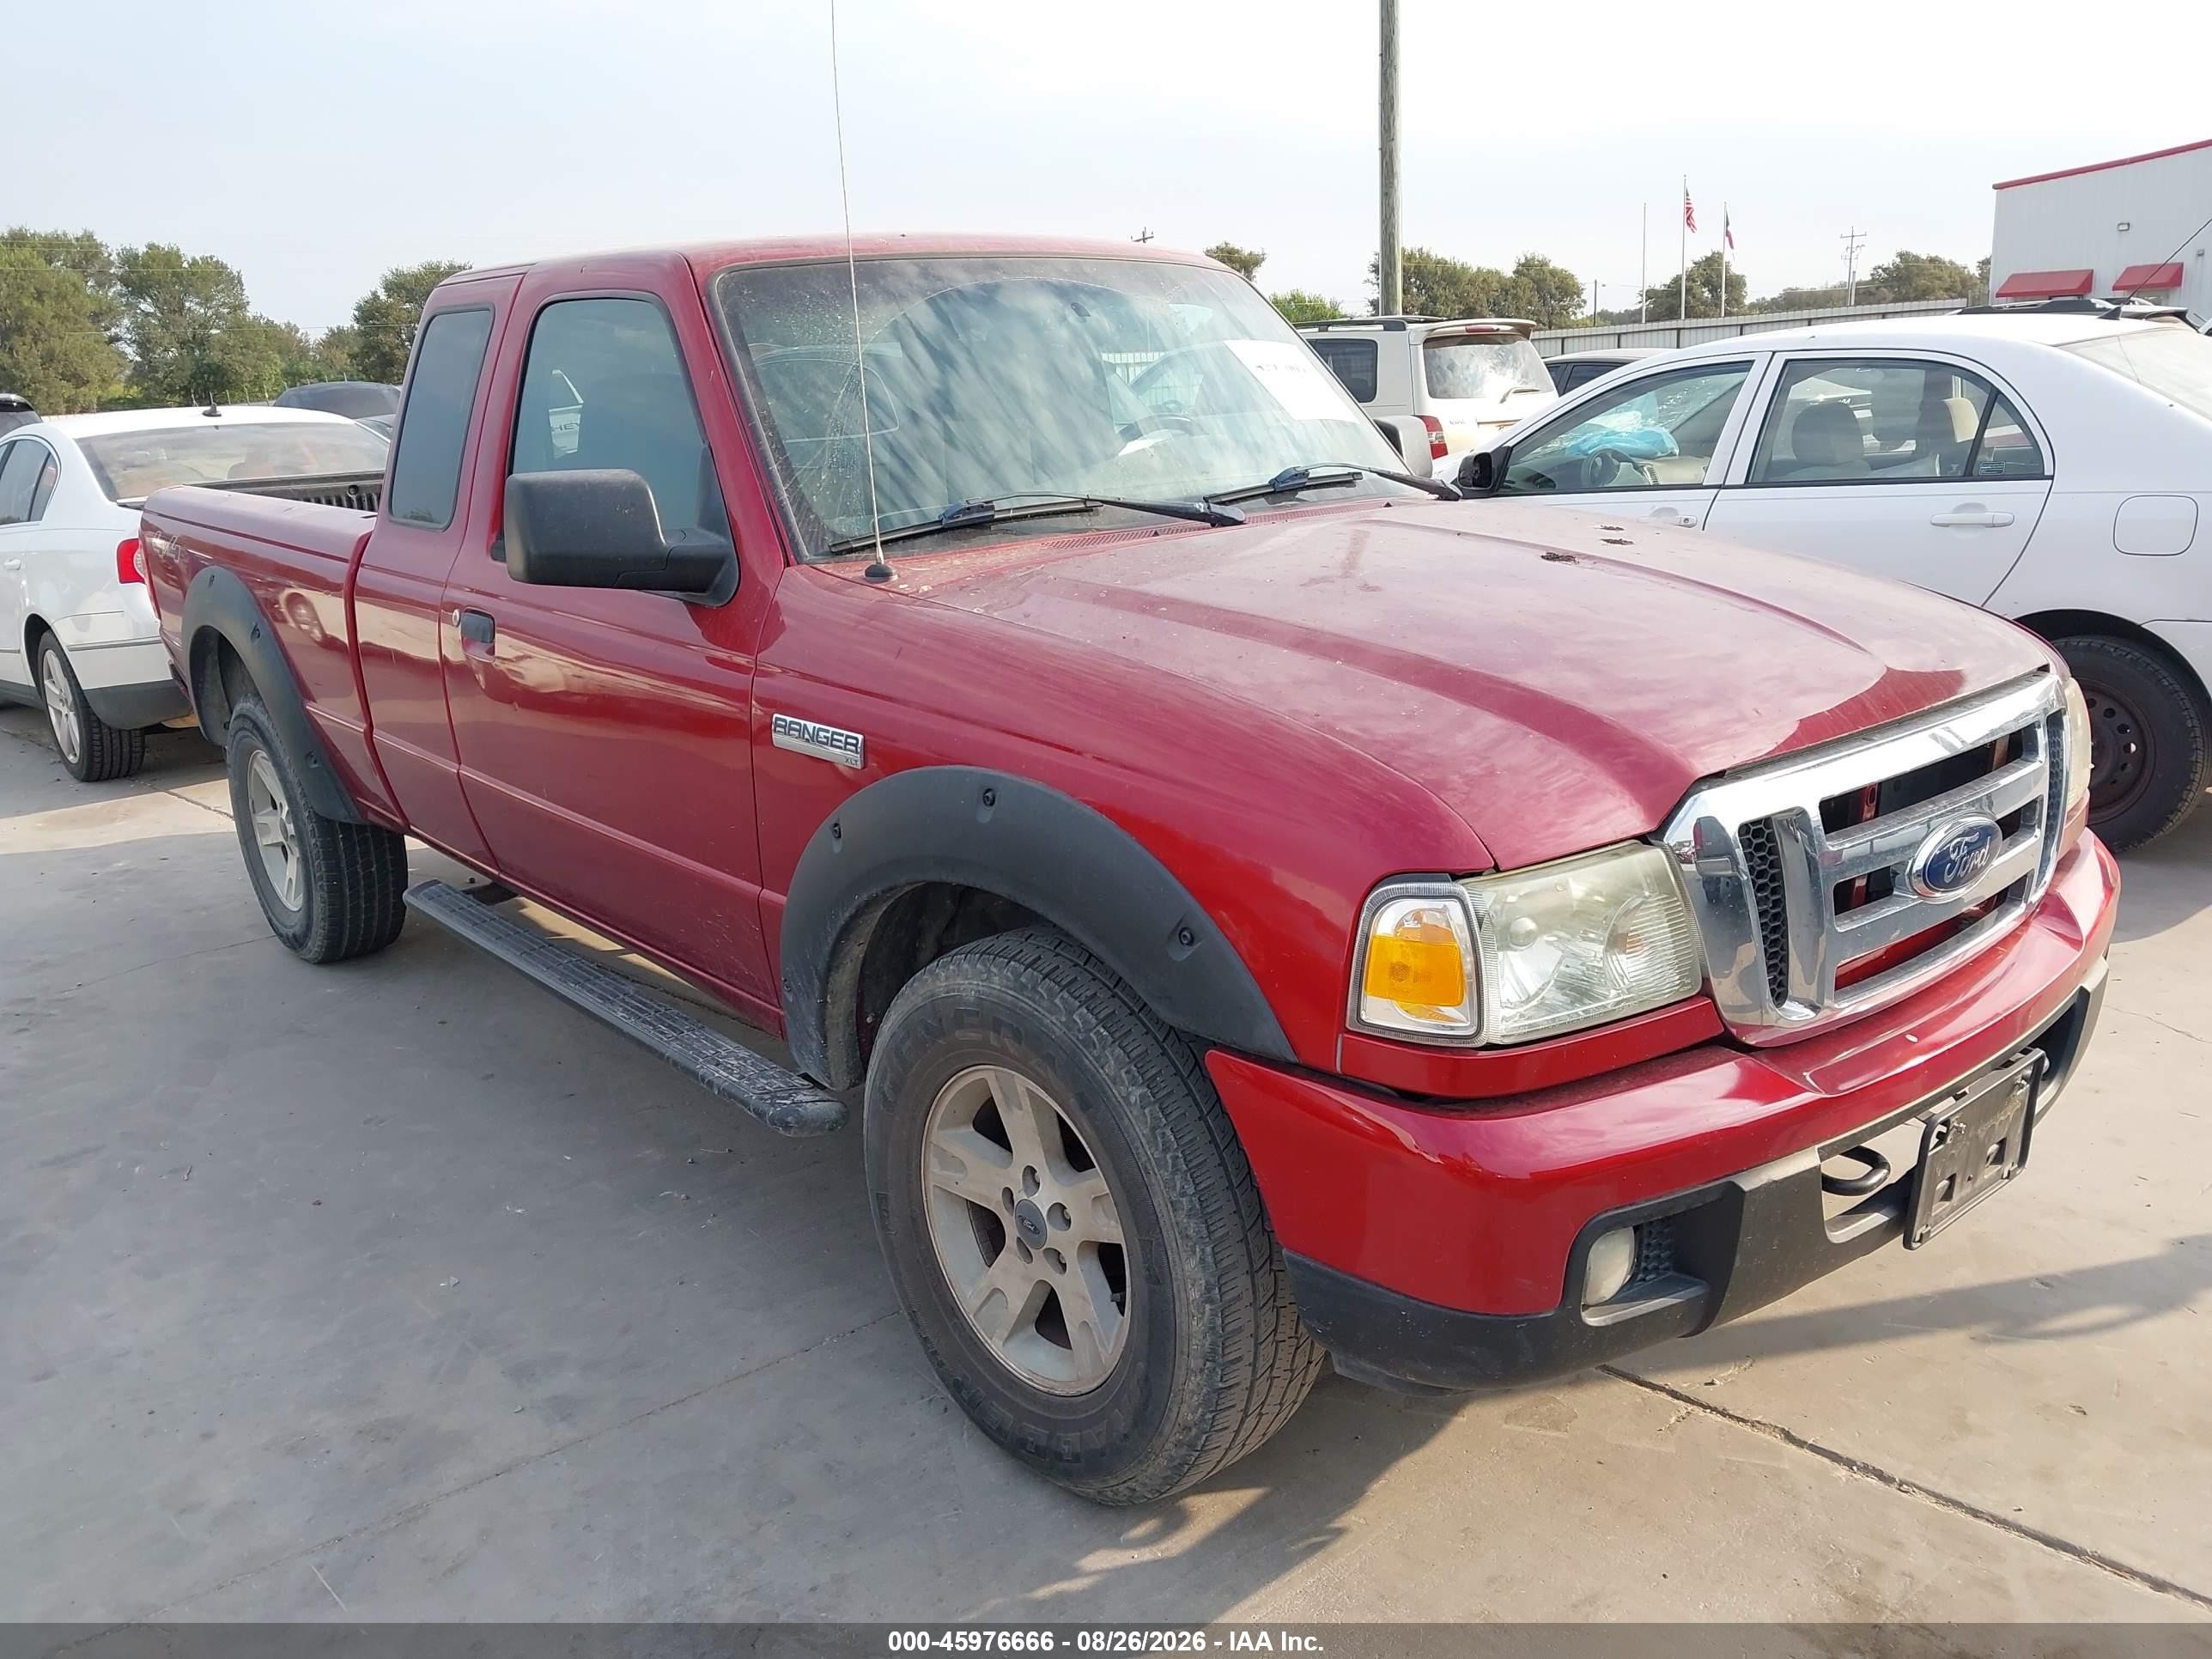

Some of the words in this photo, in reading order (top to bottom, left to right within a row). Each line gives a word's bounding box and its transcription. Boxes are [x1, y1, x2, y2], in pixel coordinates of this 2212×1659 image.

[774, 716, 860, 755] RANGER
[845, 757, 859, 766] XLT
[1943, 831, 1991, 884] Ford
